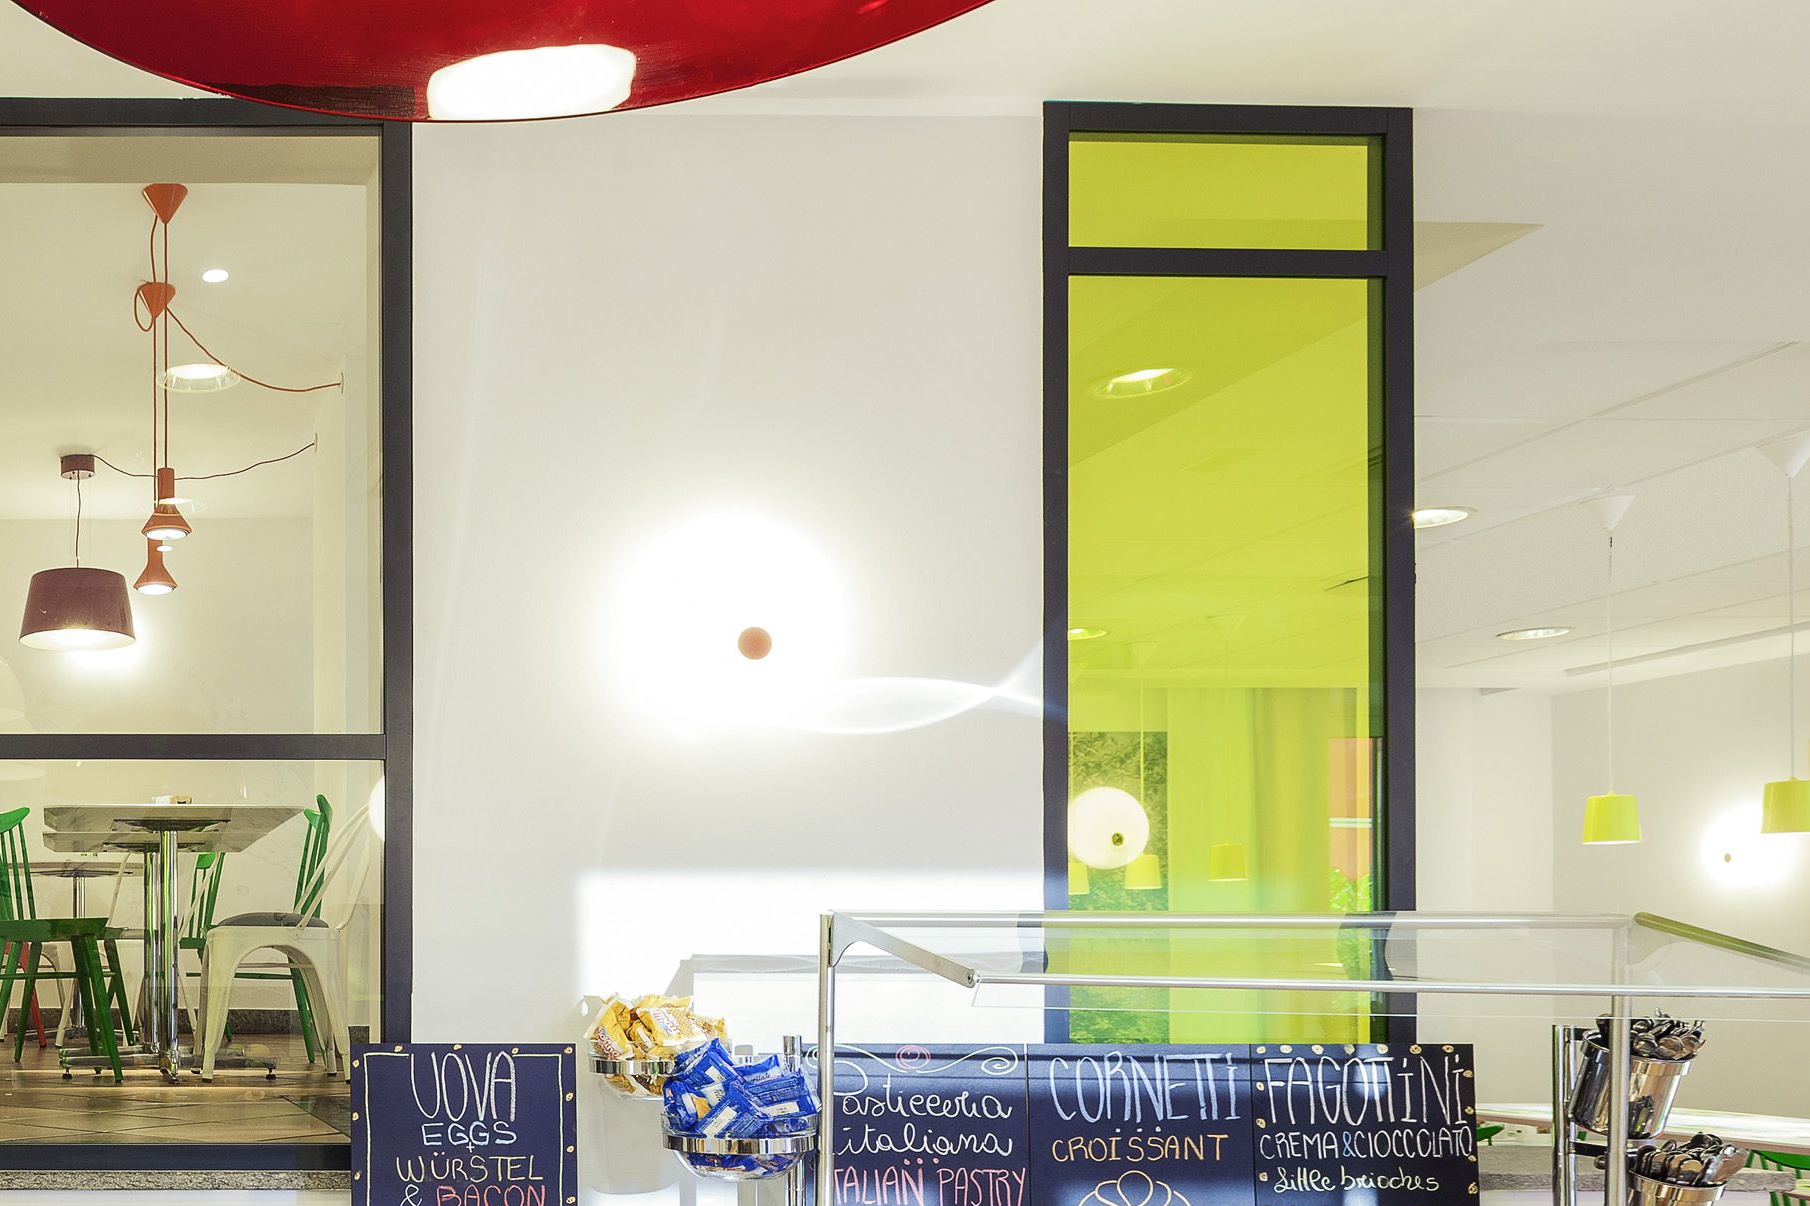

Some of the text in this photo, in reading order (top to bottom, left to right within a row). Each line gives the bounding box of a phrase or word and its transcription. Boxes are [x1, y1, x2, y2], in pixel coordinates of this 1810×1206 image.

[410, 1050, 517, 1122] UOVA
[1049, 1050, 1242, 1124] CORNETTI
[421, 1121, 518, 1146] EGGS
[837, 1122, 1014, 1157] italiana
[1051, 1133, 1230, 1163] CROISSANT
[1259, 1131, 1339, 1160] CREMA
[1353, 1125, 1473, 1159] CIOCCOLATO
[395, 1151, 544, 1182] WÜRSTEL
[1339, 1165, 1440, 1193] brioches
